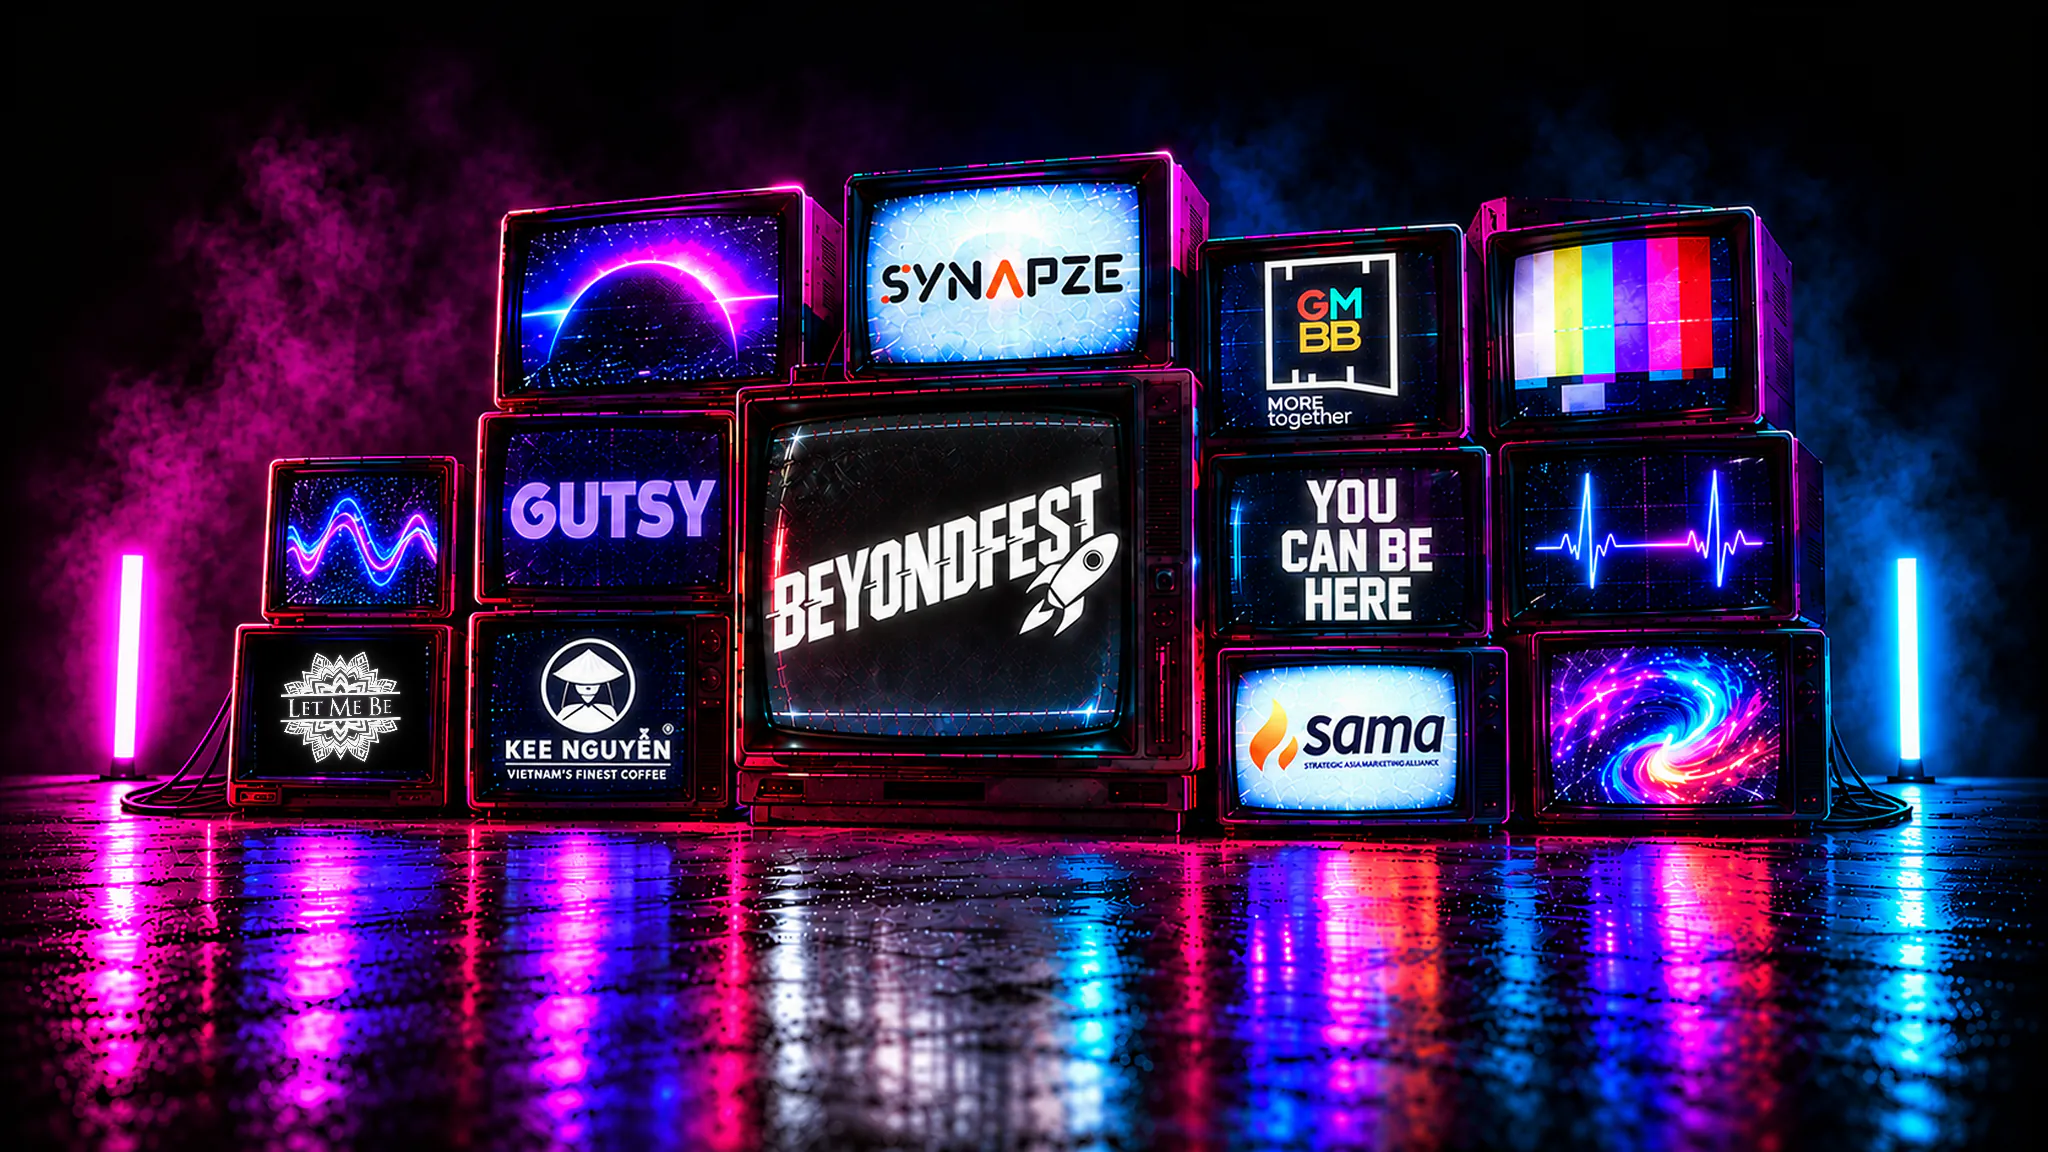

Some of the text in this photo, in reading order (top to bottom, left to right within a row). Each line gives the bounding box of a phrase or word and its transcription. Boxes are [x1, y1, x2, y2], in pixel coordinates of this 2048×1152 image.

[881, 253, 1123, 303] SYNAPZE
[1297, 287, 1362, 321] GM
[1299, 320, 1362, 353] BB
[1267, 396, 1324, 412] MORE
[1267, 408, 1353, 430] together
[510, 480, 717, 540] GUTSY
[1306, 478, 1397, 524] YOU
[766, 473, 1102, 653] BEYONDFEST
[1281, 527, 1433, 573] CAN BE
[1305, 577, 1412, 621] HERE
[505, 740, 552, 760] KEE
[1303, 714, 1446, 757] sama
[507, 769, 667, 780] VIETNAM'S FINEST COFFEE
[1304, 761, 1343, 770] STRATEGIC
[1344, 760, 1361, 769] ASIA
[1405, 759, 1440, 767] ALLIANCE
